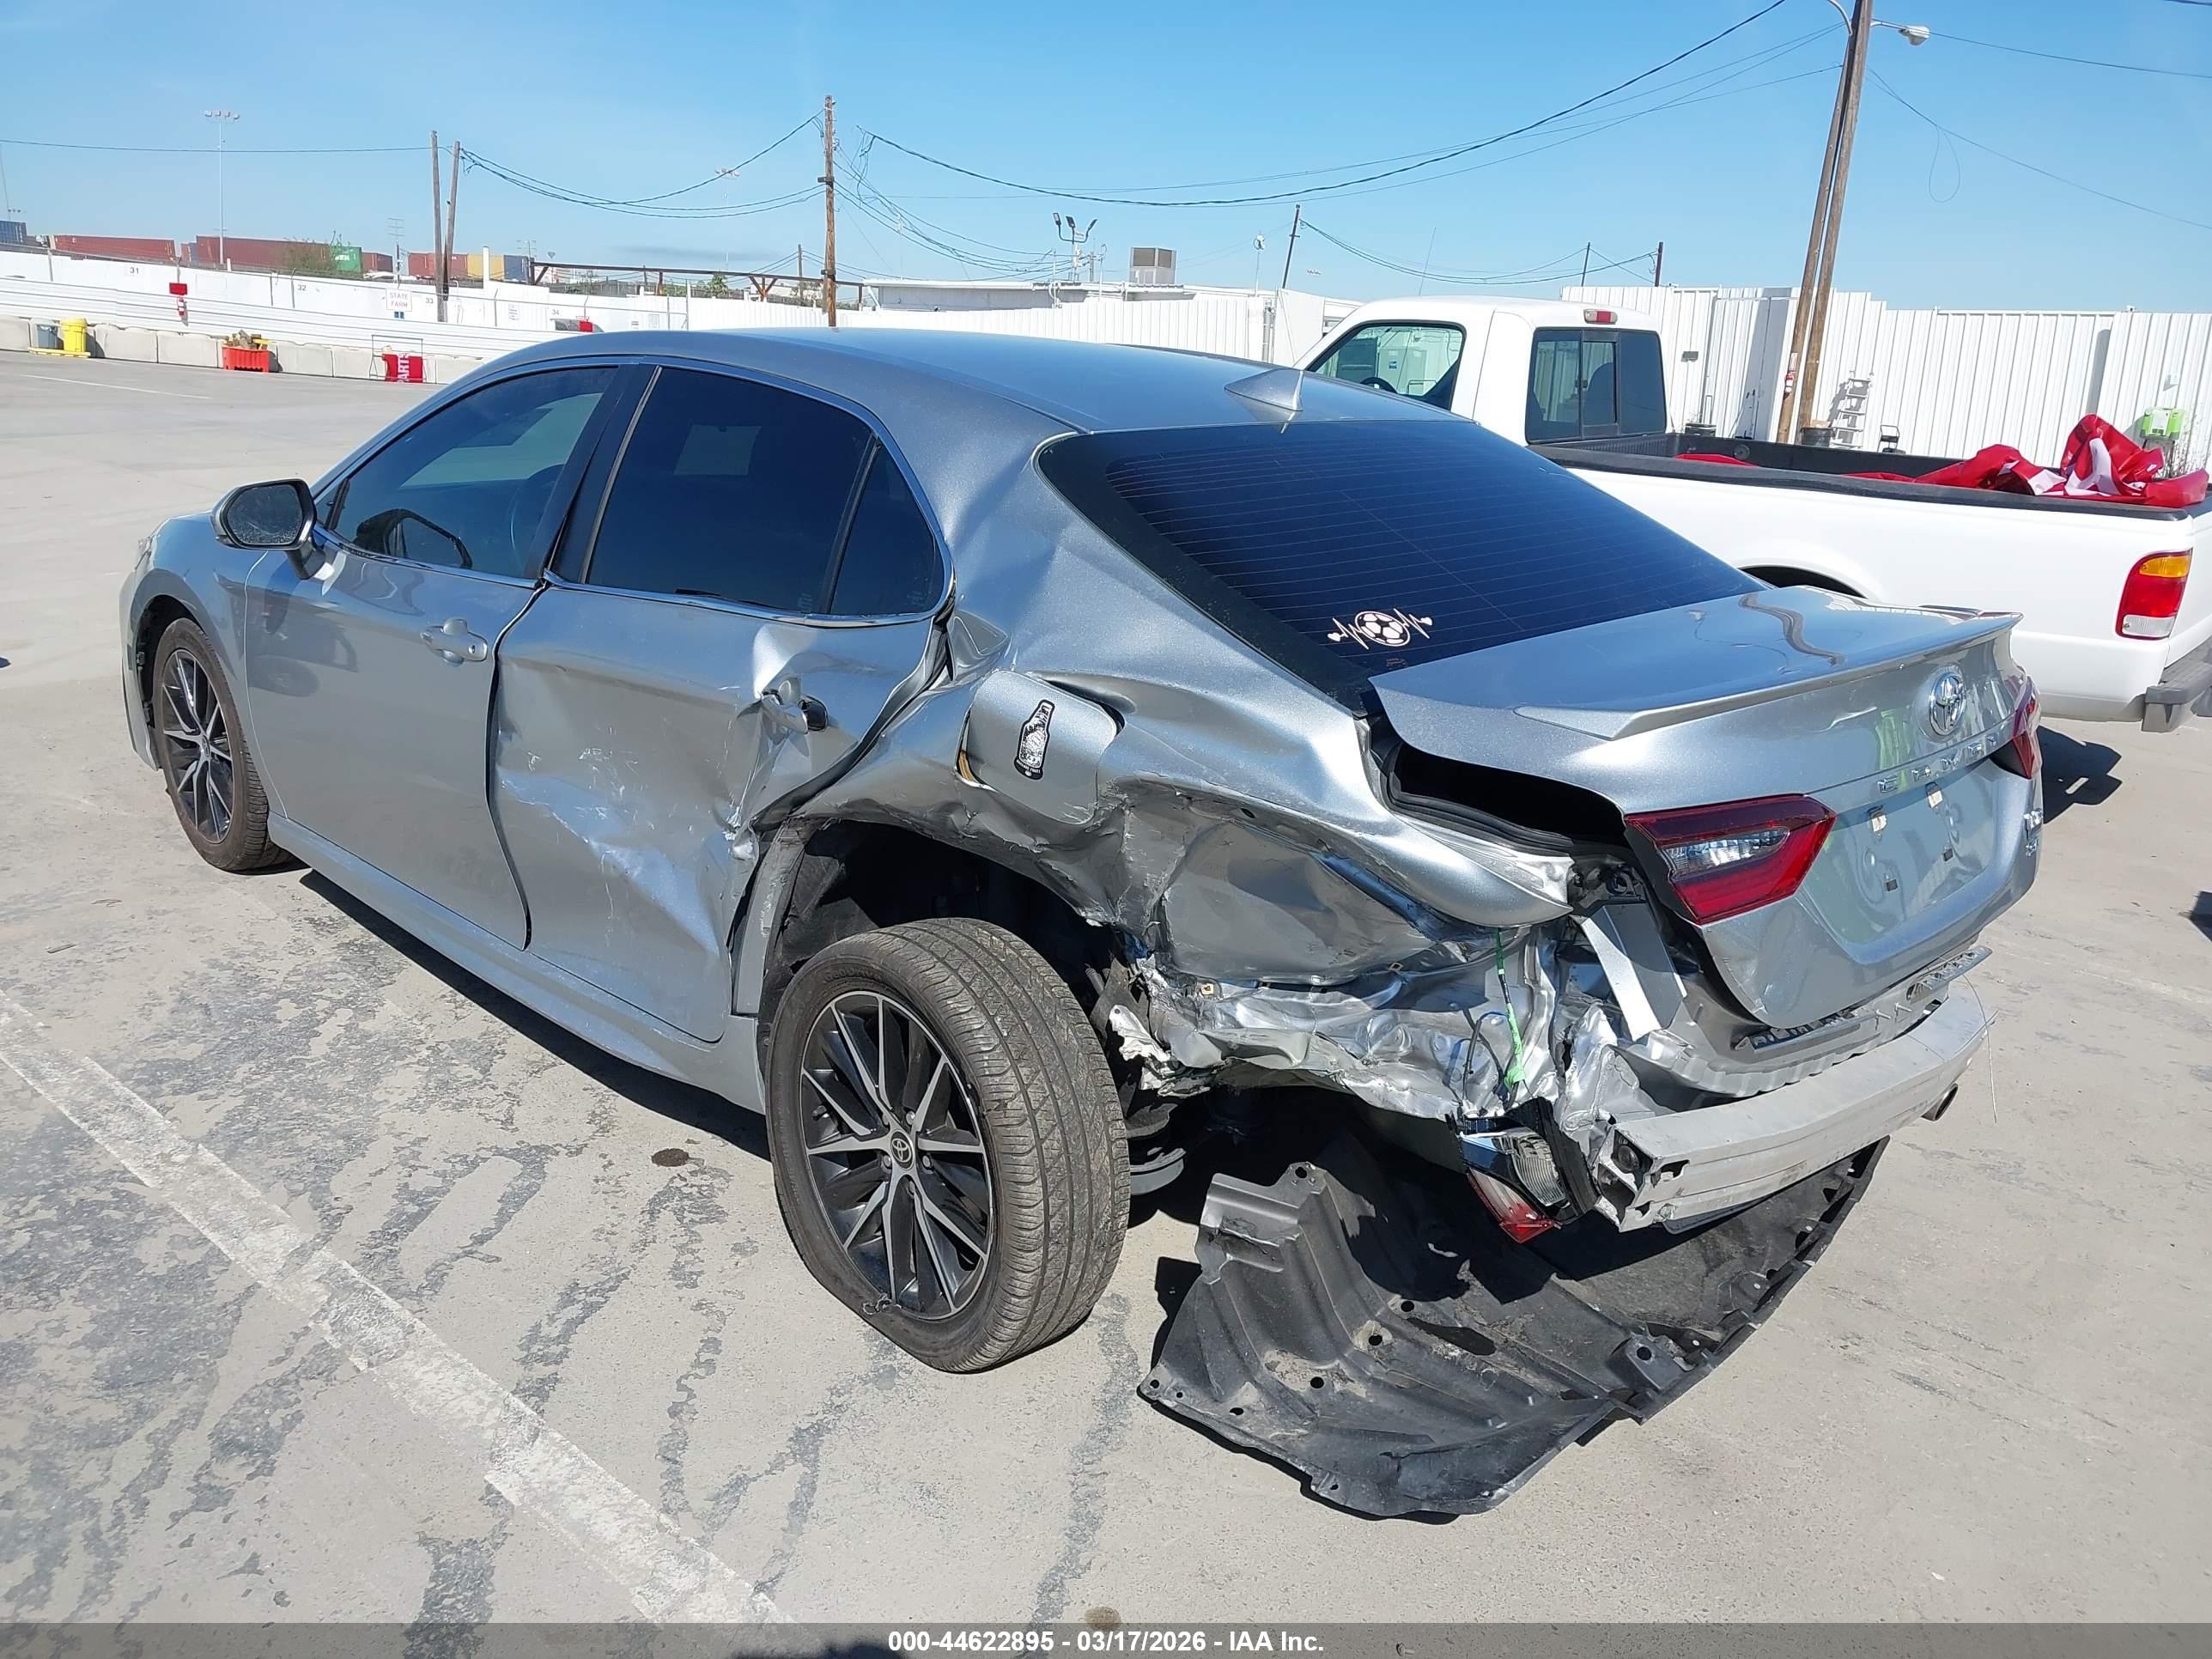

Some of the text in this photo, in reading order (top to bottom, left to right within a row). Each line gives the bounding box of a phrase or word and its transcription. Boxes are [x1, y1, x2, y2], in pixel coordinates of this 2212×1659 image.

[130, 266, 139, 275] 31
[297, 283, 307, 292] 32
[389, 292, 410, 301] STATE
